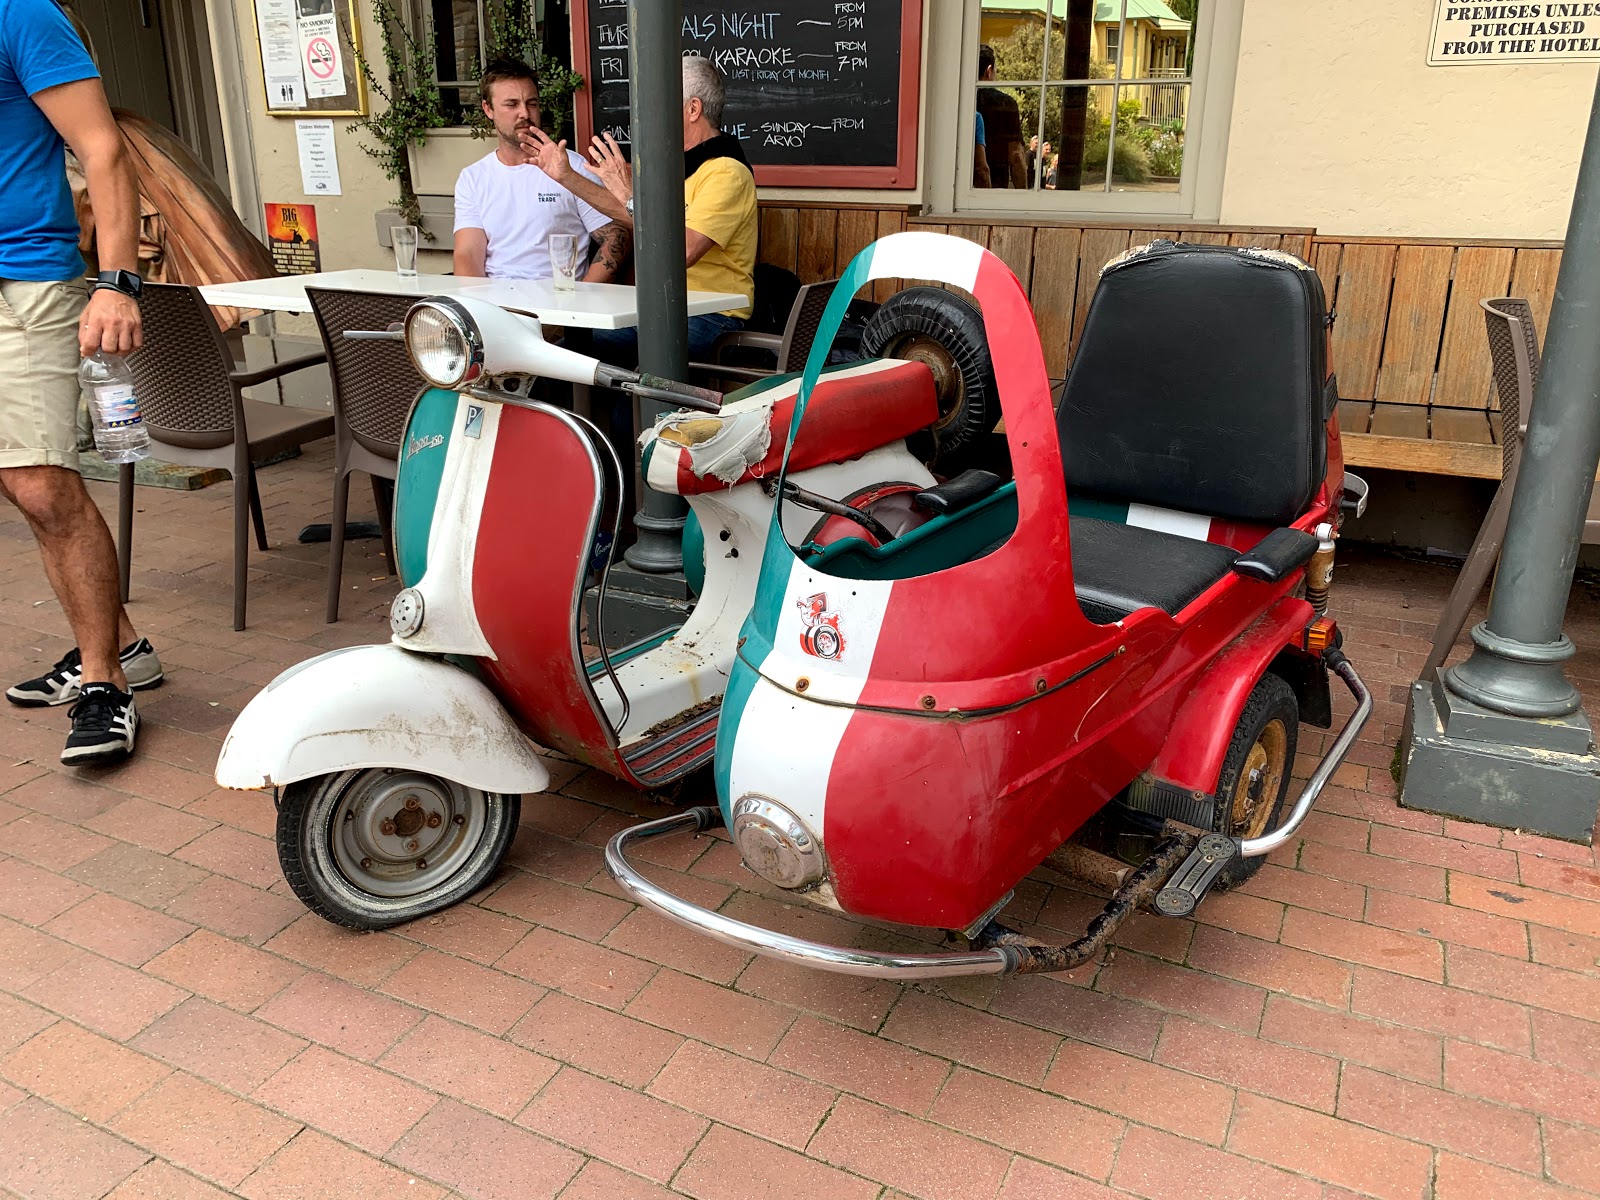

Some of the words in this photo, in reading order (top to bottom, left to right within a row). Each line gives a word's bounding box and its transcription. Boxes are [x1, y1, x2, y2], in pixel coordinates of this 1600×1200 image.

[834, 2, 866, 14] FROM
[1445, 4, 1541, 20] PREMISES
[681, 13, 716, 42] ALS
[721, 12, 781, 40] NIGHT
[1469, 20, 1585, 37] PURCHASED
[834, 41, 867, 53] FROM
[1442, 40, 1494, 55] FROM
[1498, 39, 1536, 54] THE
[1539, 38, 1600, 52] HOTEL
[601, 58, 623, 78] FRI
[732, 69, 750, 80] LAST
[751, 69, 780, 82] FRIDAY
[782, 69, 795, 82] OF
[798, 69, 829, 81] MONTH
[720, 123, 750, 139] UE
[760, 122, 811, 138] SUNDAY
[832, 117, 864, 132] FROM
[763, 133, 802, 147] ARVO
[281, 208, 297, 221] BIG
